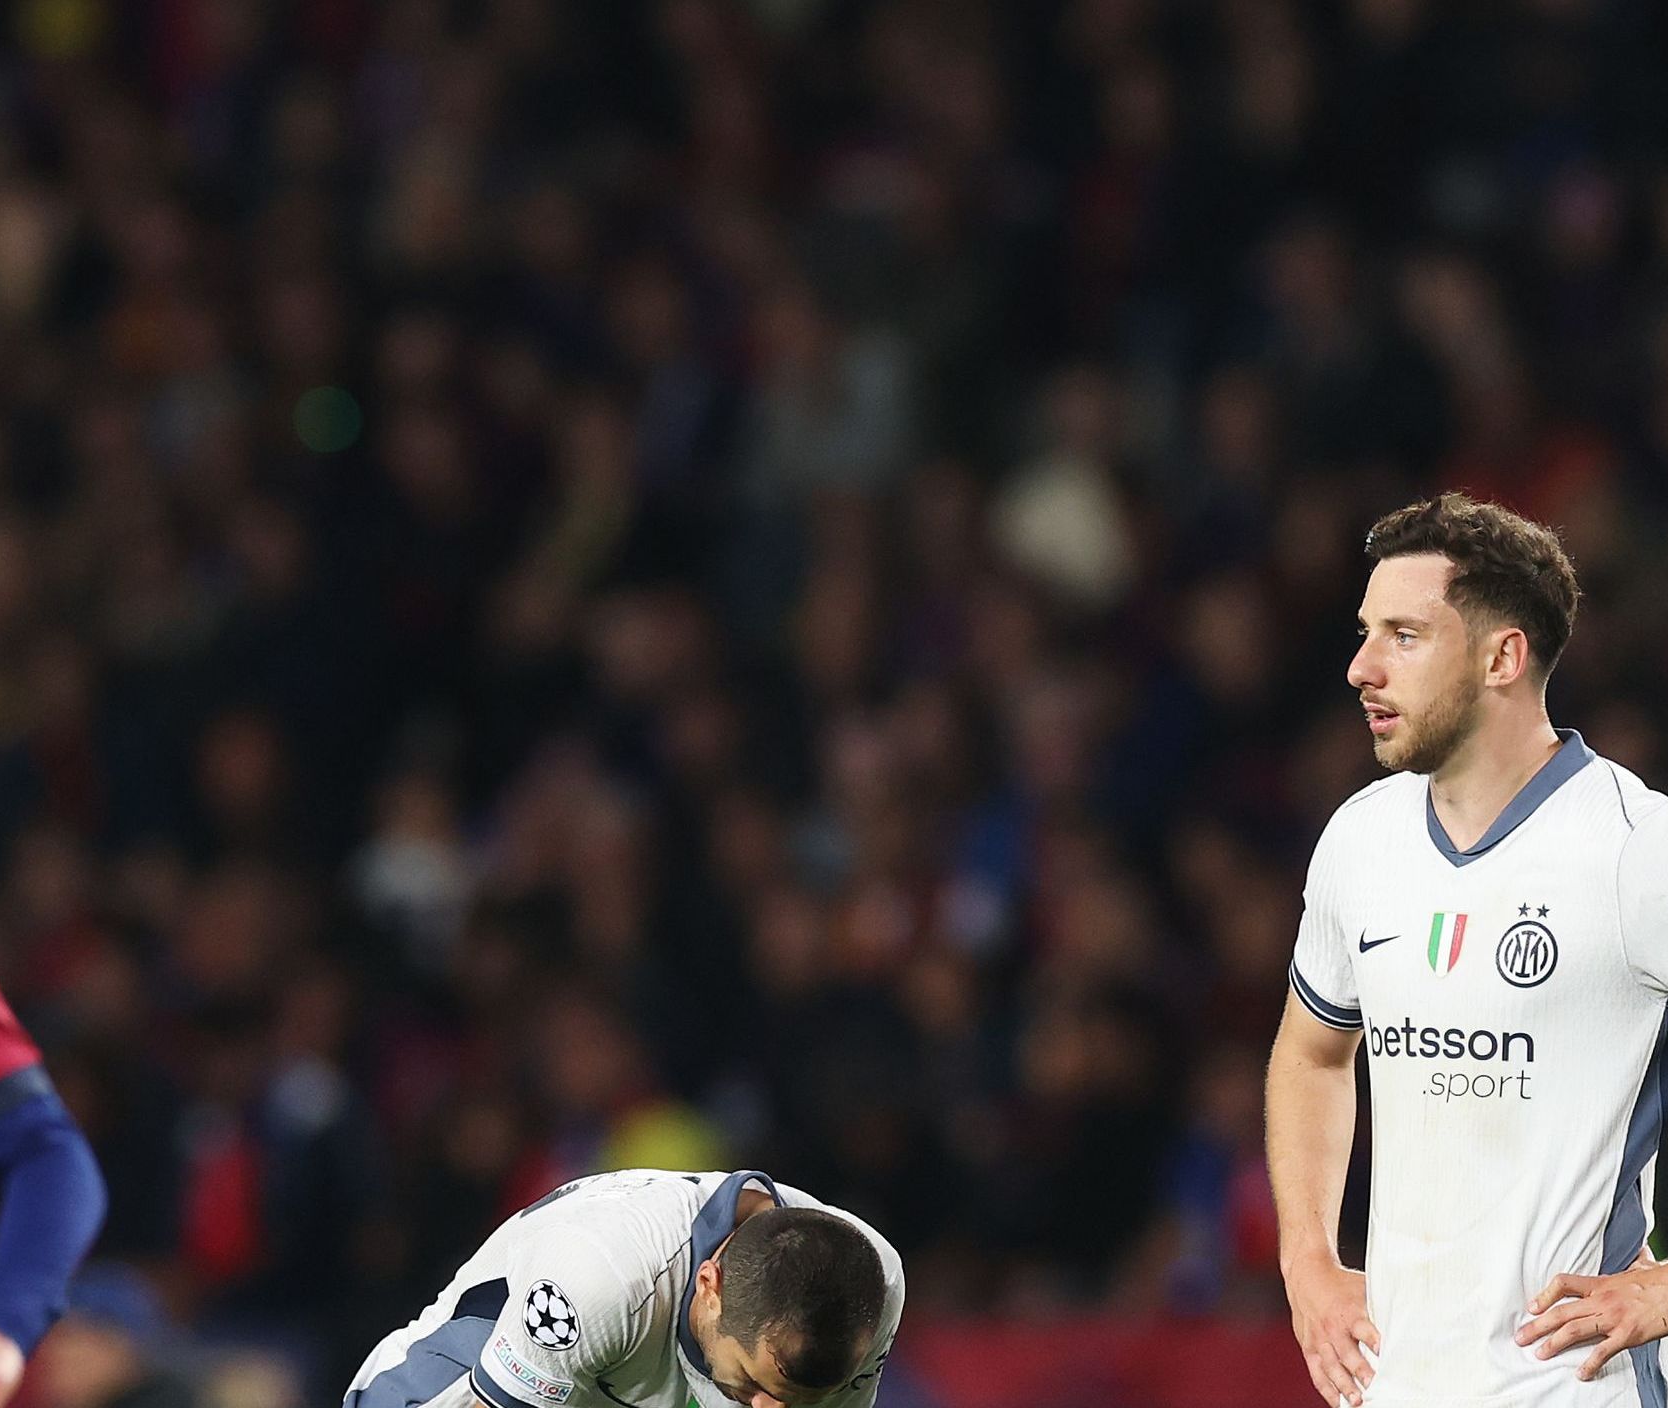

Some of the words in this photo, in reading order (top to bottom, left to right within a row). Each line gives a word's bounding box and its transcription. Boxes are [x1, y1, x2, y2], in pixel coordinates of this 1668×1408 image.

[1369, 1016, 1535, 1063] betsson
[1422, 1069, 1532, 1104] .sport
[494, 1339, 571, 1398] FOUNDATION
